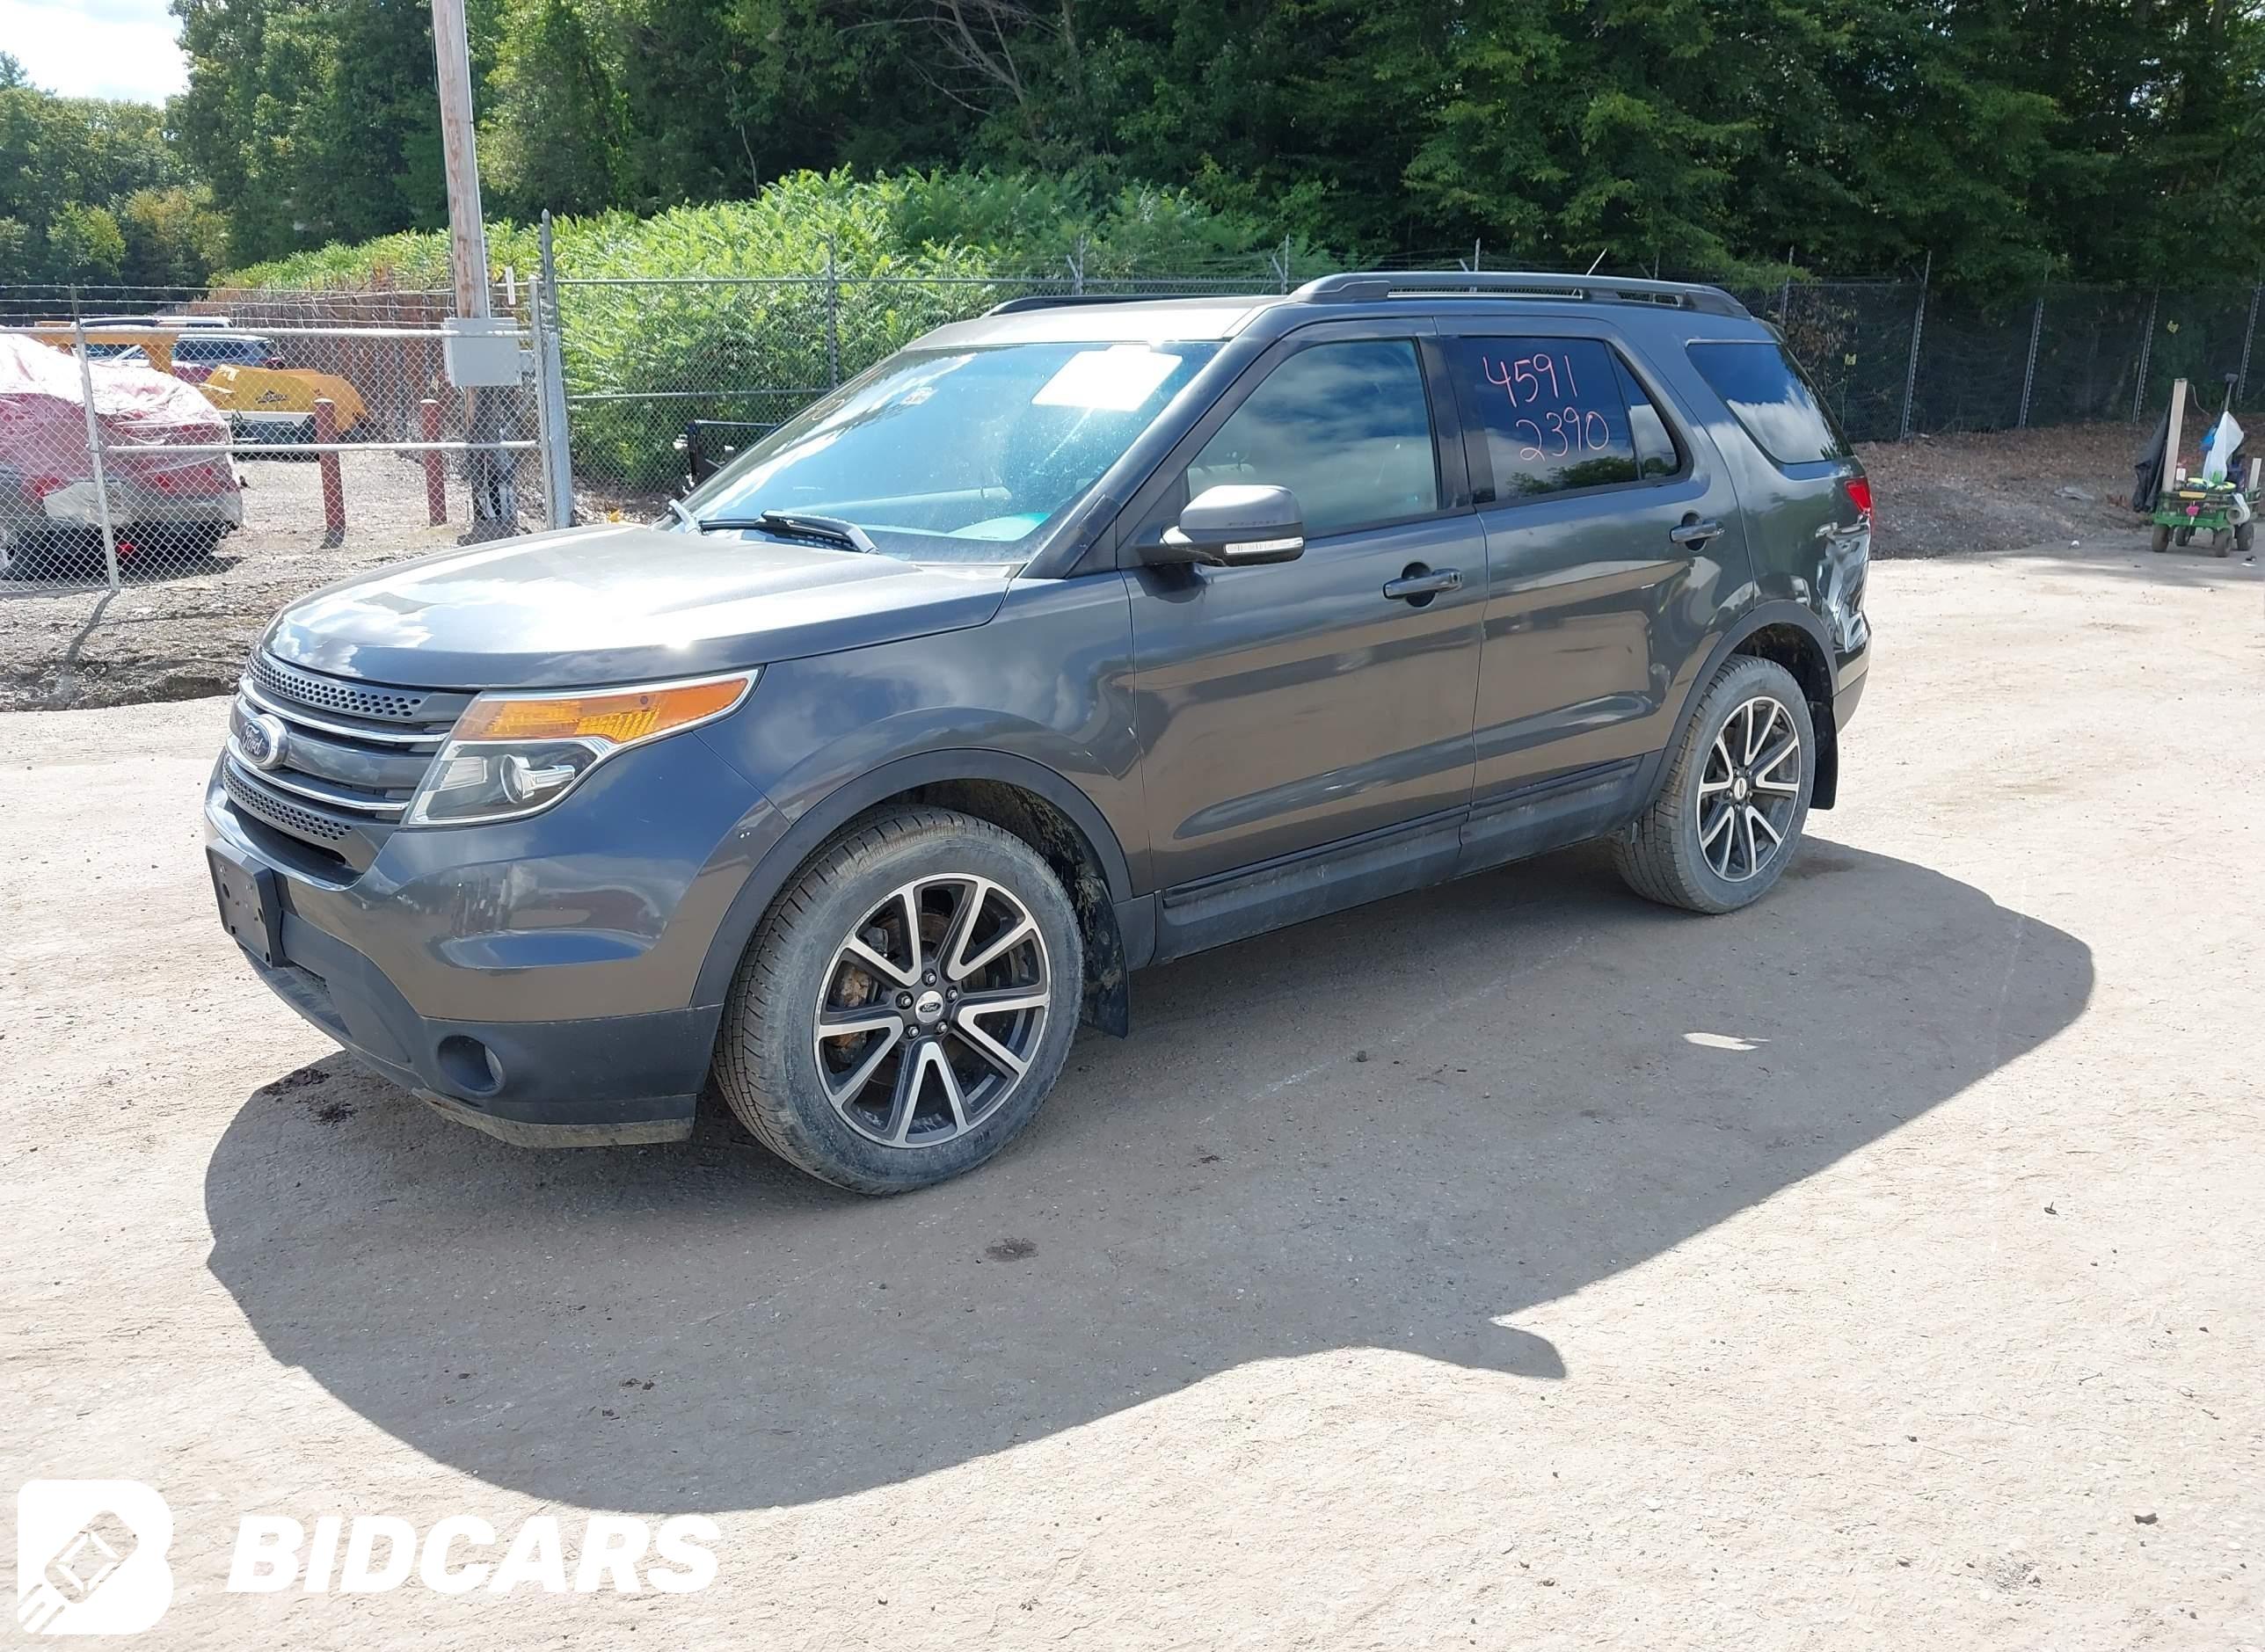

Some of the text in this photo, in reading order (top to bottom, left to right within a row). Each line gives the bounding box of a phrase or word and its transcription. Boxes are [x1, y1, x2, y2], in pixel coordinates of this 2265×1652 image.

[1482, 353, 1578, 408] 4591
[1515, 406, 1610, 462] 2390
[242, 724, 264, 755] Ford
